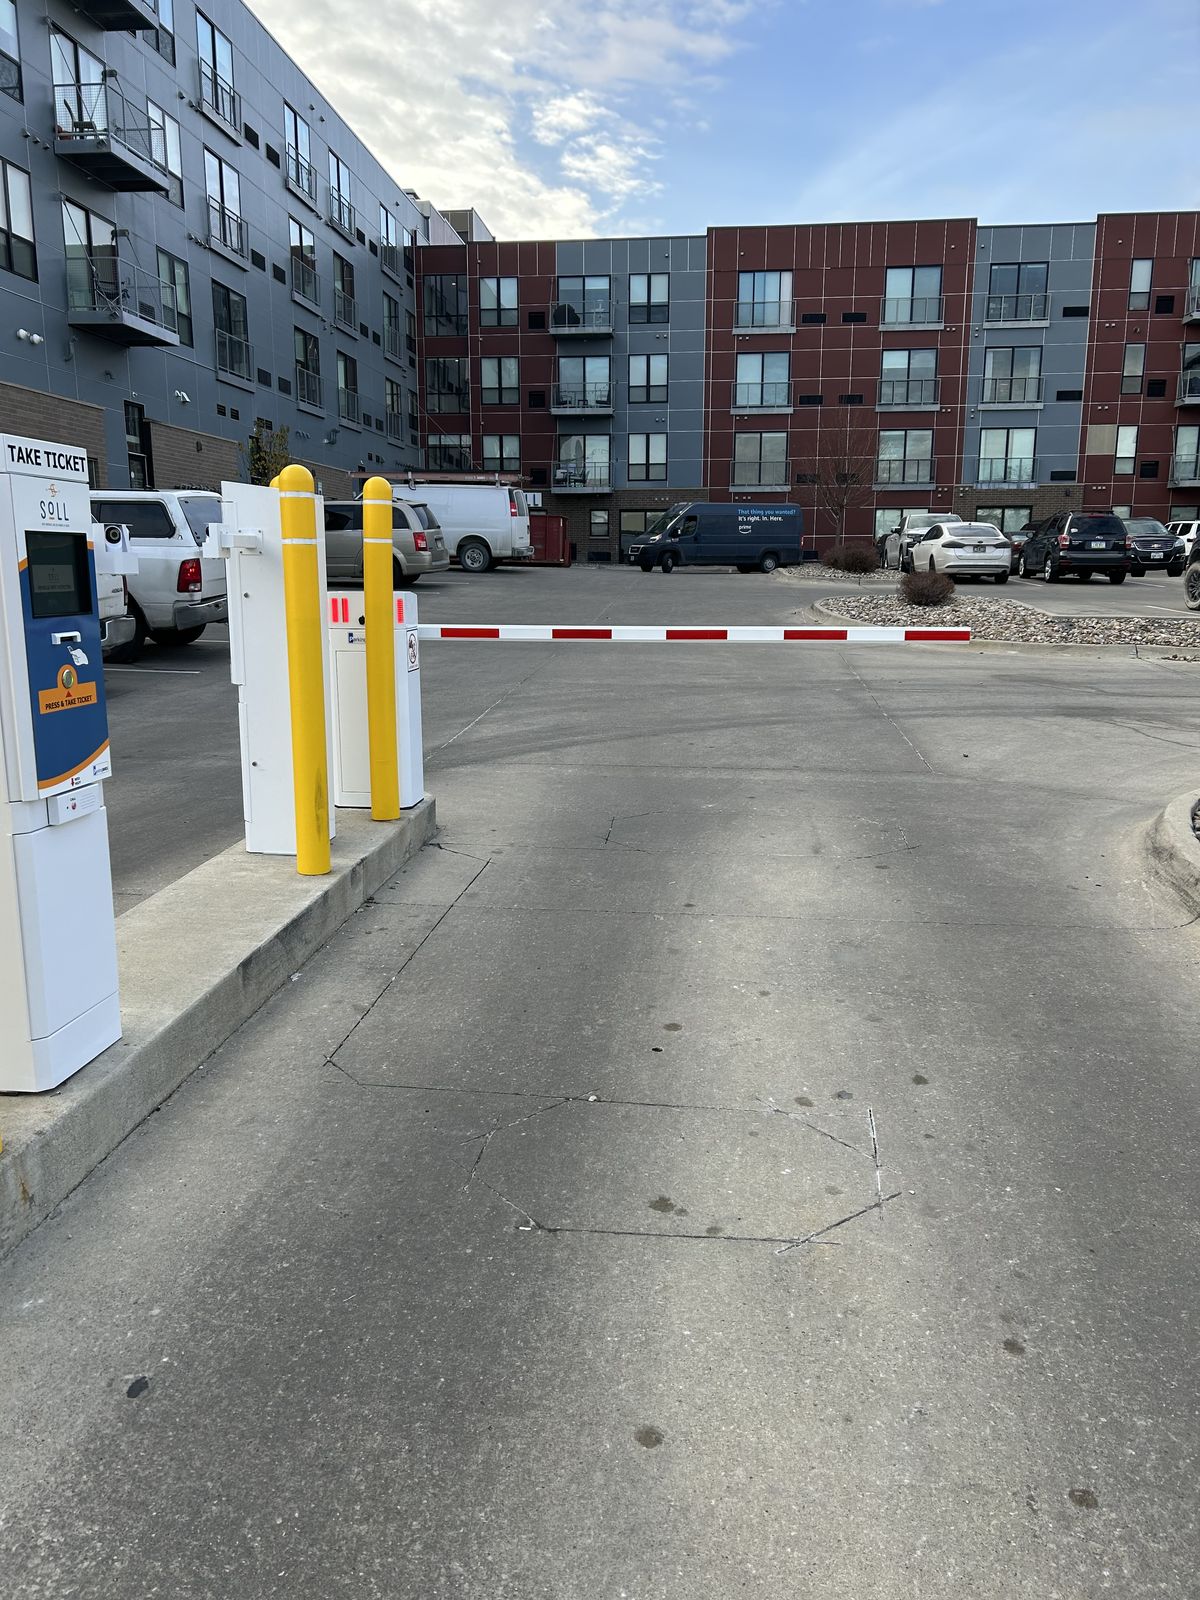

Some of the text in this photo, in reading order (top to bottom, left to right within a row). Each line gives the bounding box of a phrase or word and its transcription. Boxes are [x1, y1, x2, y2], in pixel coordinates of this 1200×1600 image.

[8, 444, 86, 472] TAKE TICKET
[39, 500, 70, 521] SOLL
[750, 508, 764, 516] thing
[747, 515, 762, 523] right.
[45, 700, 60, 711] PRESS
[64, 697, 77, 707] TAKE
[77, 695, 92, 705] TICKET
